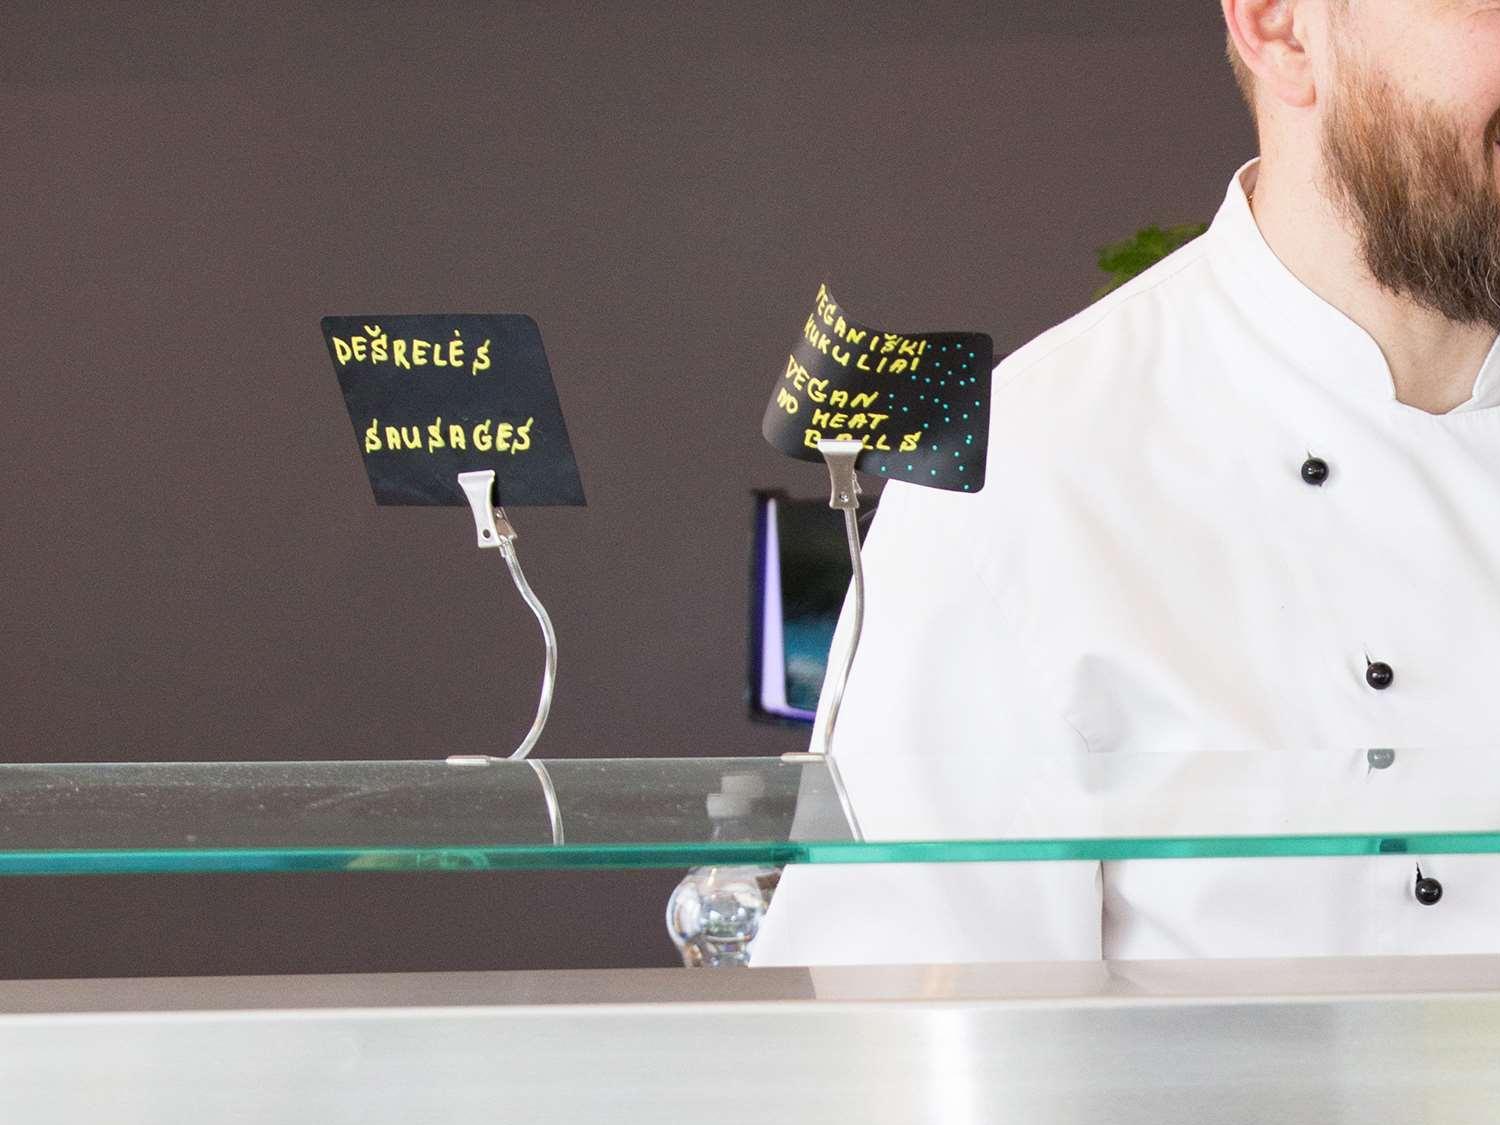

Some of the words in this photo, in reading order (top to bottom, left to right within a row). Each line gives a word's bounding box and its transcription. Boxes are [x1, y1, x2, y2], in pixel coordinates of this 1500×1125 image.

[784, 354, 879, 409] VEGAN
[365, 416, 535, 455] SAUSAGES
[811, 408, 890, 430] MEAT
